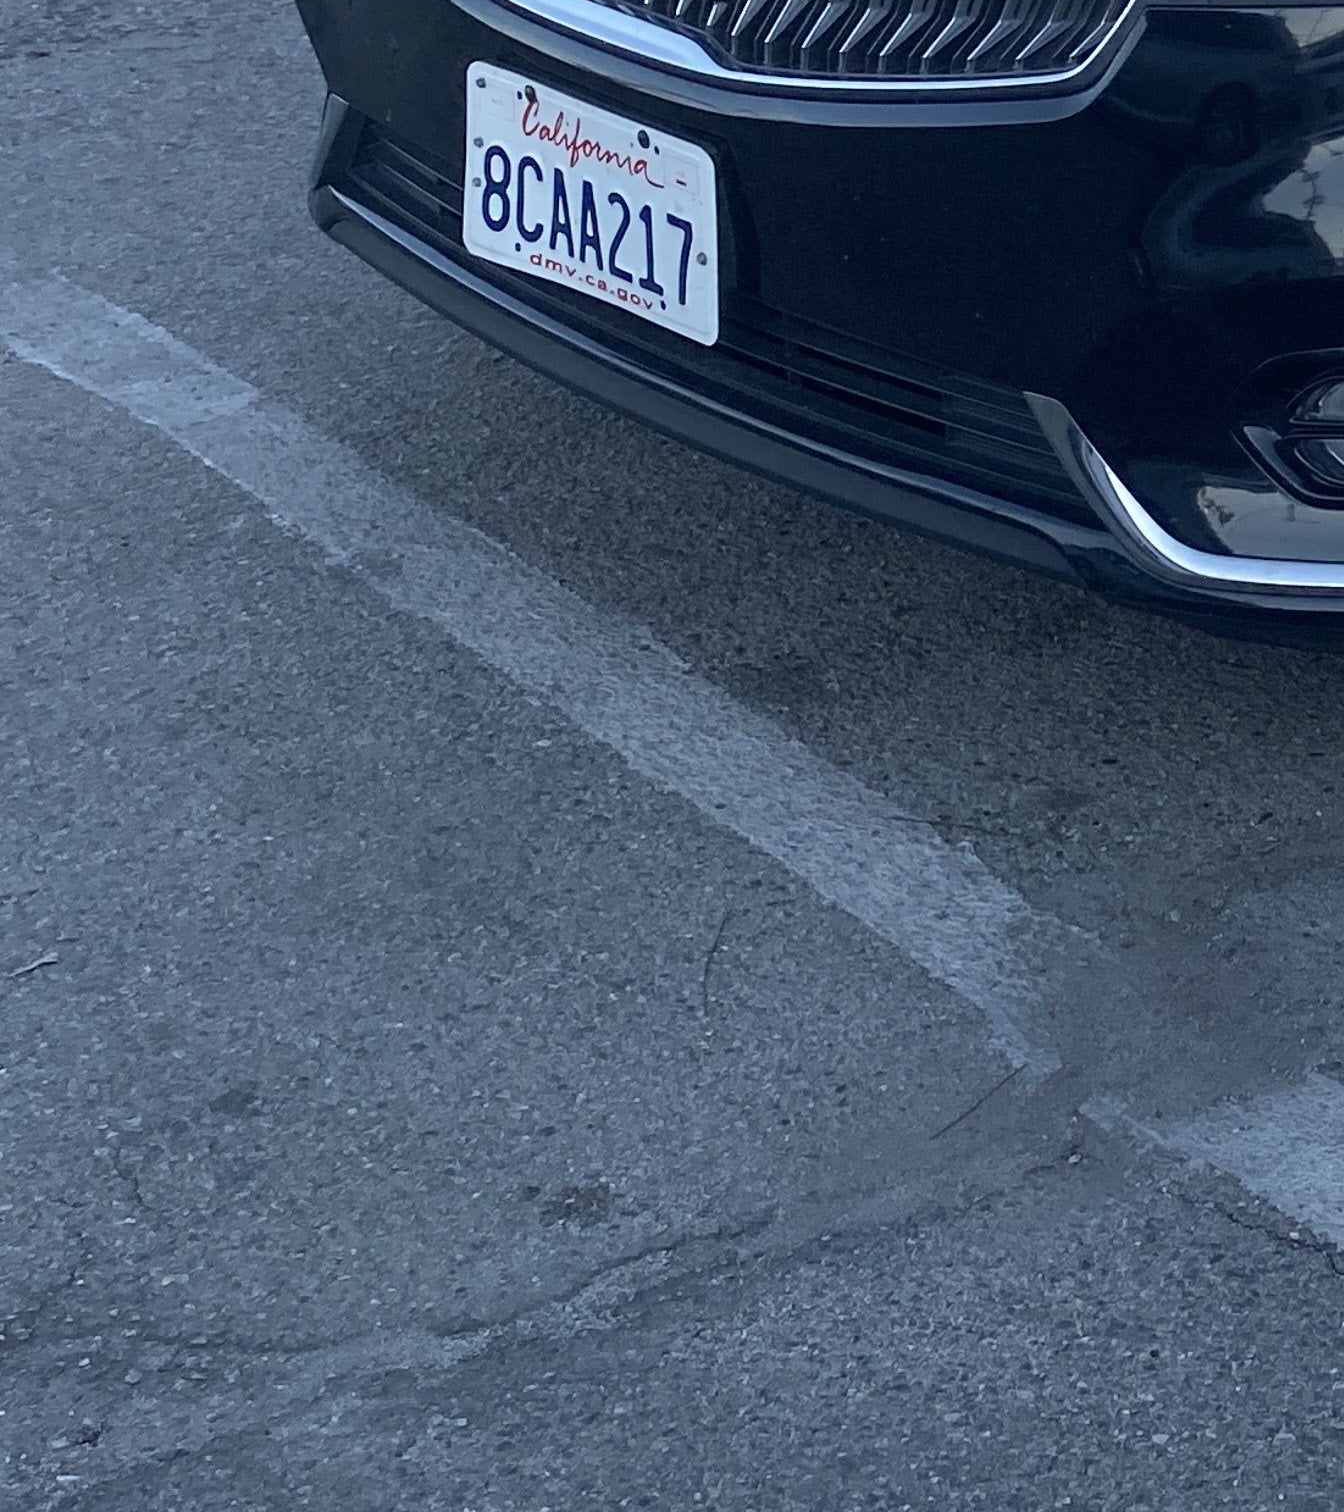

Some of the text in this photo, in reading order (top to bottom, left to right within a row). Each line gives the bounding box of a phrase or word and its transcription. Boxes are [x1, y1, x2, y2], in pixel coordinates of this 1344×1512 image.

[521, 94, 665, 189] California
[481, 145, 693, 306] 8CAA217
[529, 252, 653, 310] dmv.ca.gov
